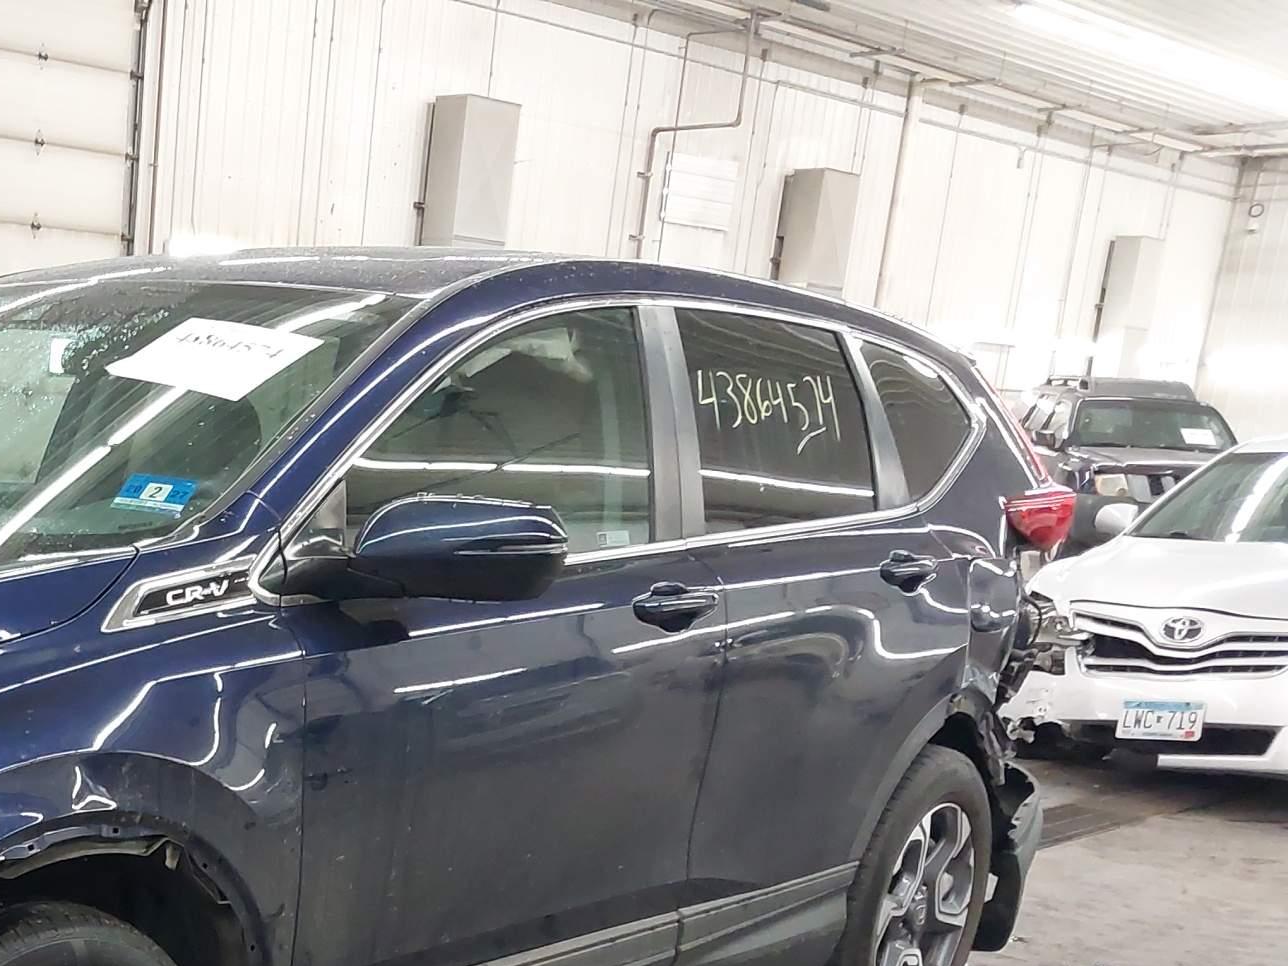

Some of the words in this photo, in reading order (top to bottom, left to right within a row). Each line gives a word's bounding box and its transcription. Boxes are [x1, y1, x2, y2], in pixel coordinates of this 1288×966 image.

[696, 369, 841, 455] 43864574
[148, 486, 163, 499] 2
[169, 489, 189, 500] 27
[165, 579, 229, 606] CR-V
[1167, 710, 1198, 731] 719
